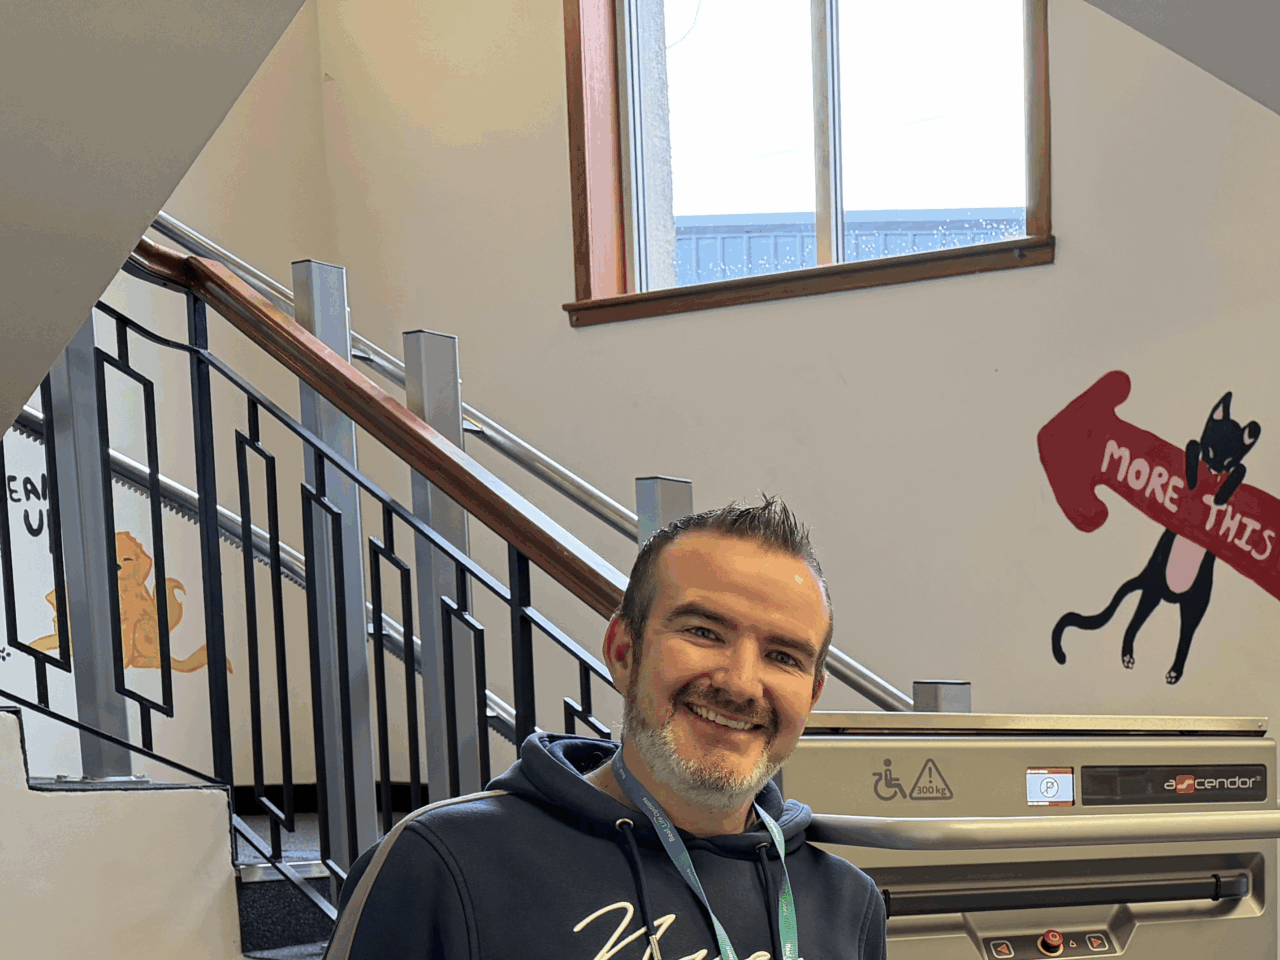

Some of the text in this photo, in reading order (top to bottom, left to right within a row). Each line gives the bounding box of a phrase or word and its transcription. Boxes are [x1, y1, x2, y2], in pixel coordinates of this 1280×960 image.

[1100, 439, 1184, 513] MORE
[1202, 493, 1275, 560] THIS
[917, 785, 947, 798] 300 kg
